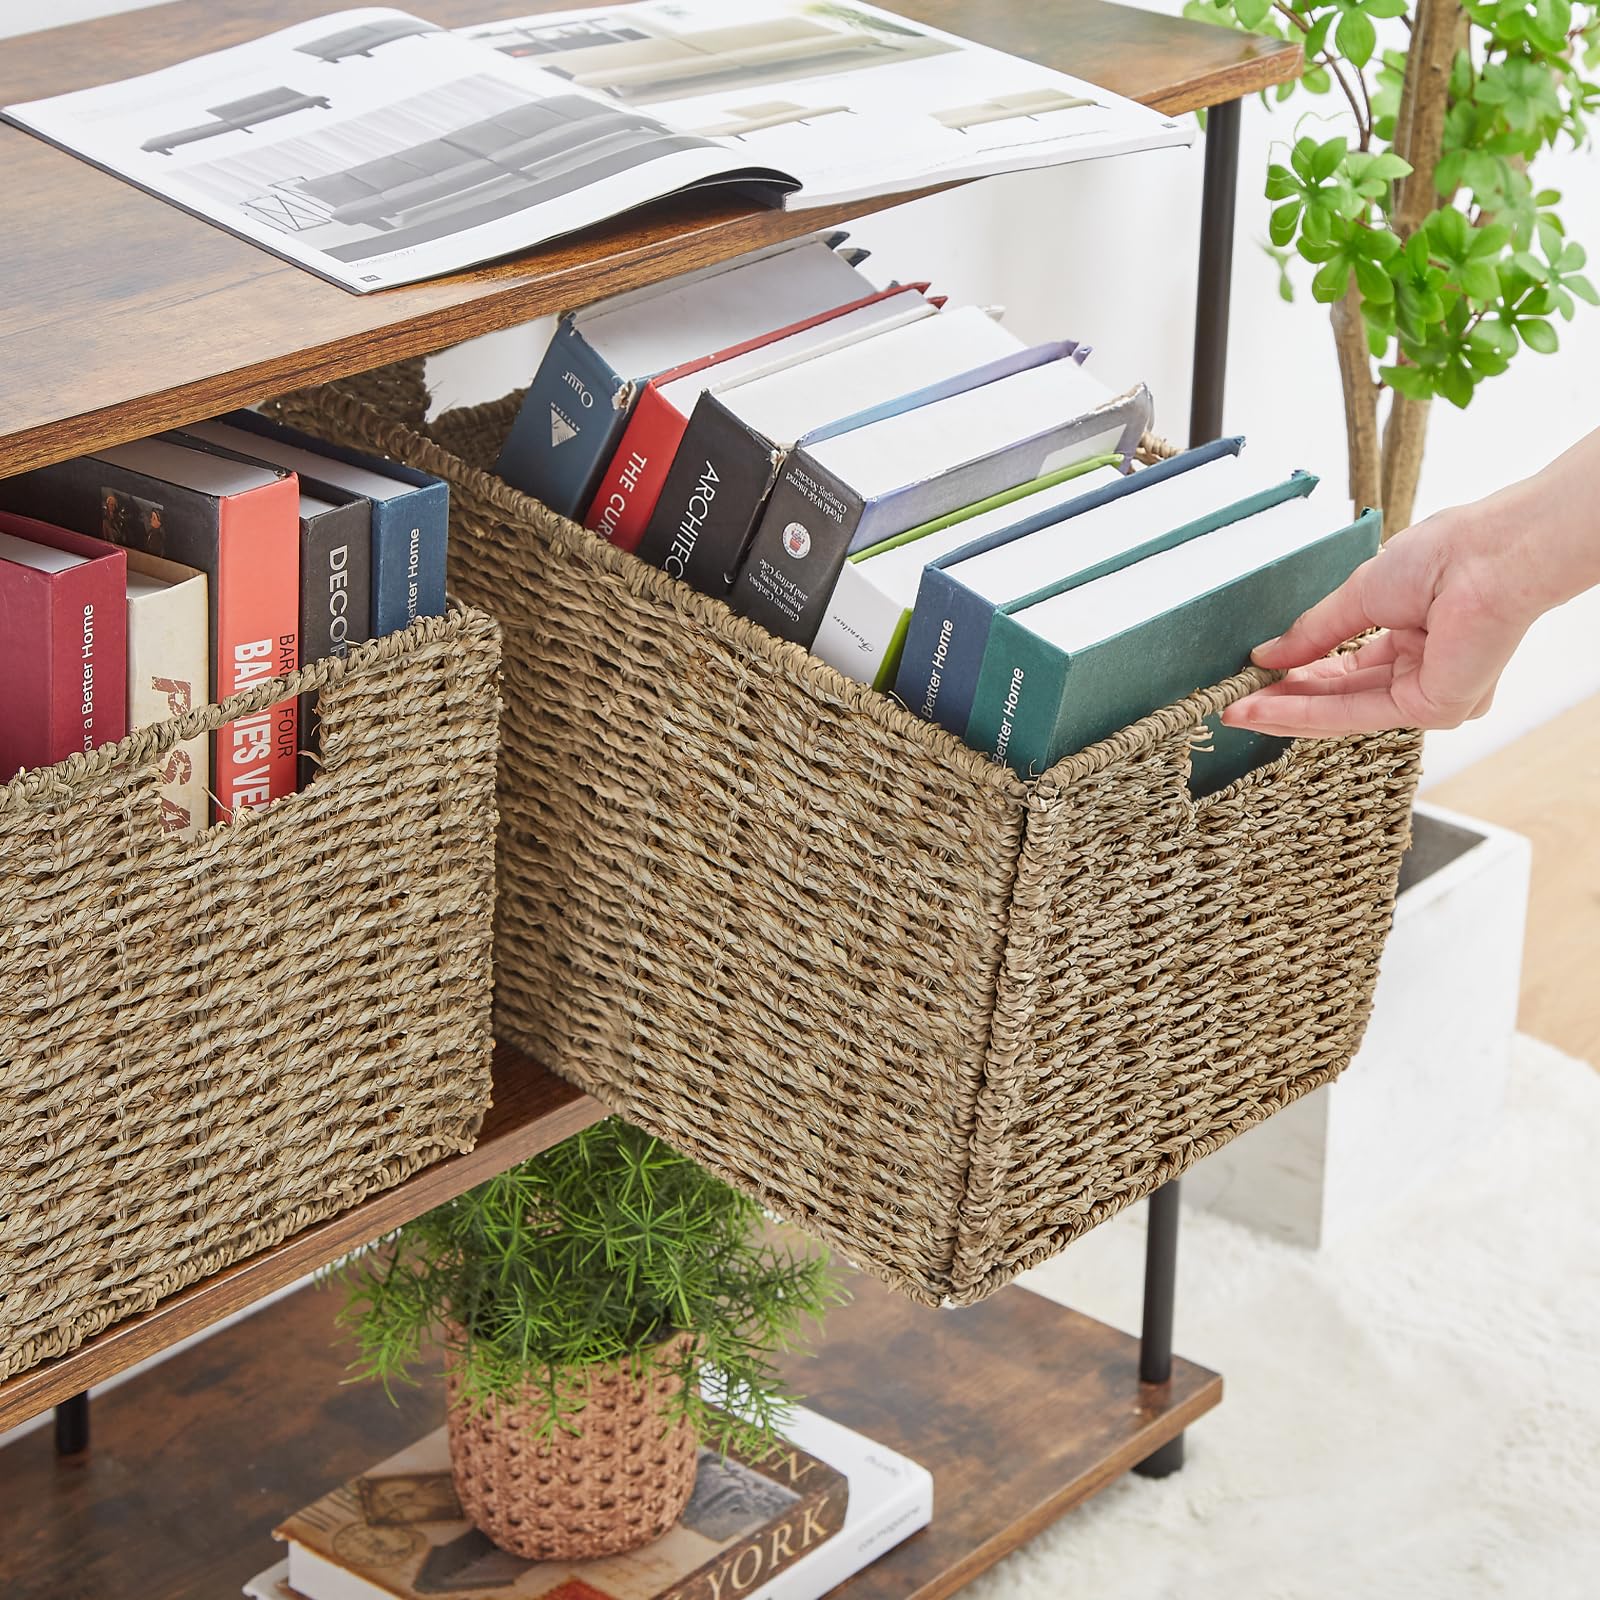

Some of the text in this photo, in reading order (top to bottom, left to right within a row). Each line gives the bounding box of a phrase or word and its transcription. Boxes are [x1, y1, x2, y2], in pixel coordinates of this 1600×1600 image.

[550, 402, 580, 431] ARTISAN
[596, 452, 647, 538] THE CUR
[786, 472, 842, 523] World Wide Internet
[794, 468, 846, 514] Changing Societies
[660, 460, 720, 579] ARCHITEC
[408, 528, 419, 578] Home
[749, 573, 799, 622] Gustavo Cardoso,
[760, 559, 808, 601] and Jeffrey Cole
[783, 592, 804, 612] Angus
[82, 604, 94, 658] Home
[832, 616, 873, 652] Furniture
[82, 663, 93, 715] Better
[921, 619, 954, 719] Better Home
[83, 718, 93, 728] a
[278, 708, 294, 759] FOUR
[992, 667, 1024, 766] Better Home
[152, 676, 192, 832] PSA
[232, 764, 270, 813] VE
[705, 1496, 829, 1600] YORK
